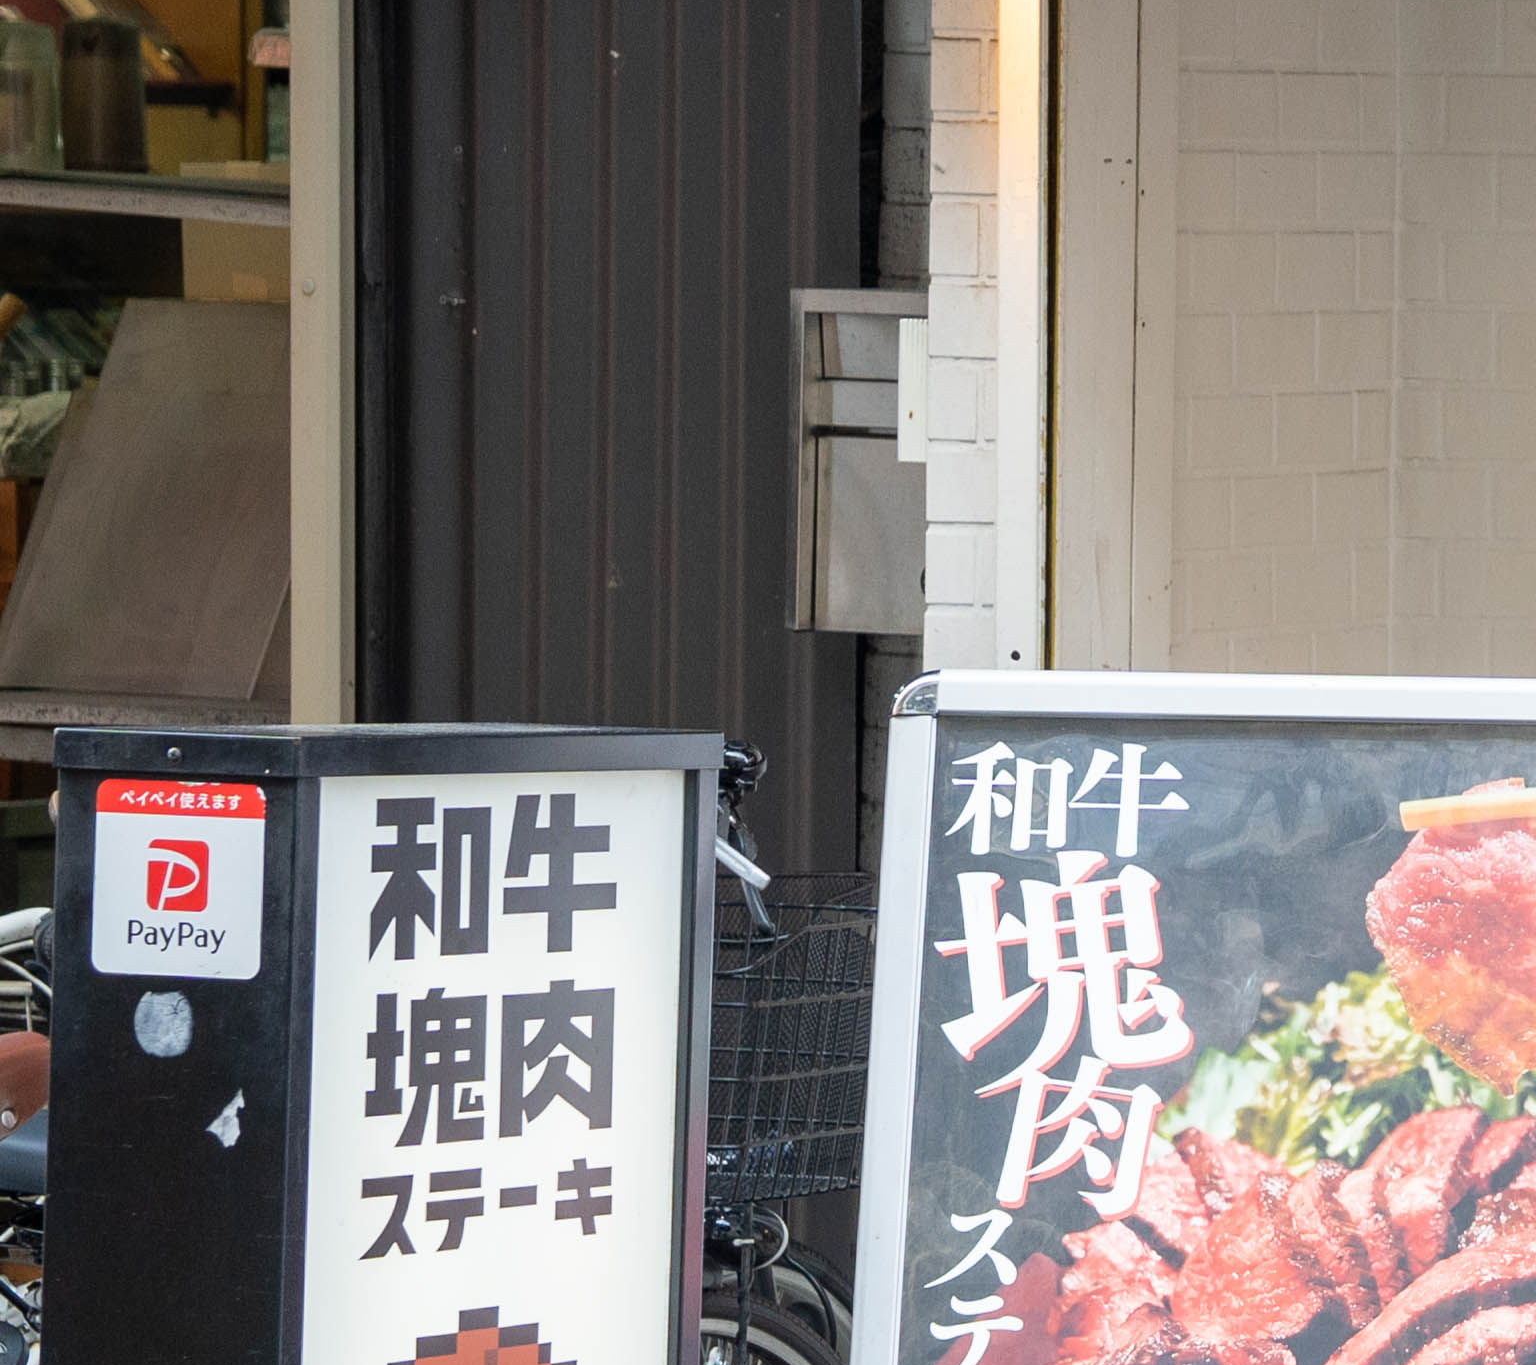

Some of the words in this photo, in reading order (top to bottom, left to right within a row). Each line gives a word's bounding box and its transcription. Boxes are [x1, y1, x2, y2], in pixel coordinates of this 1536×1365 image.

[119, 790, 242, 811] ペイペイ使えます
[950, 742, 1190, 860] 和牛
[127, 919, 226, 954] PayPay
[369, 793, 617, 962] 和牛
[364, 978, 615, 1148] 塊肉
[934, 849, 1195, 1222] 塊肉
[359, 1158, 613, 1261] ステーキ
